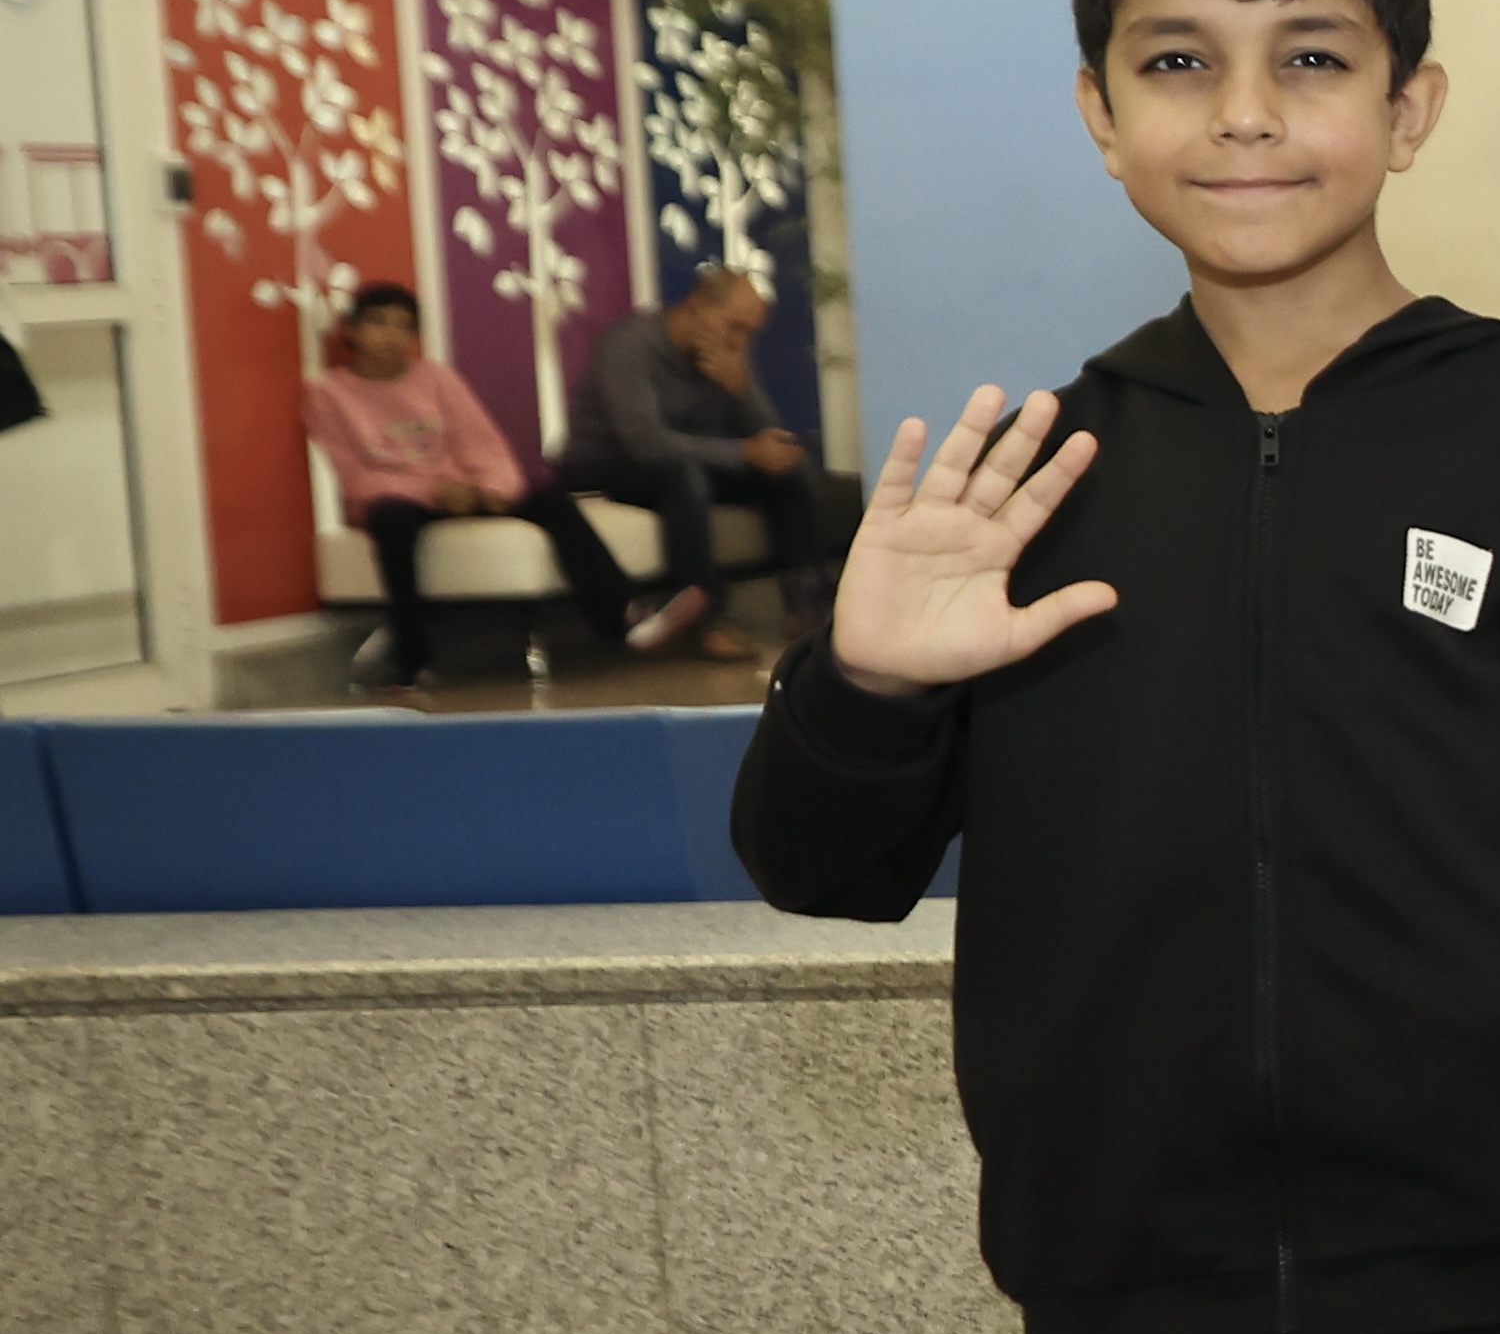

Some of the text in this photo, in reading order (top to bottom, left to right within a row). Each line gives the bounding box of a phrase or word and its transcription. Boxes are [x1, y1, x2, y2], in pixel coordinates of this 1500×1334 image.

[1416, 537, 1435, 560] BE
[1413, 561, 1477, 601] AWESOME
[1412, 584, 1454, 616] TODAY
